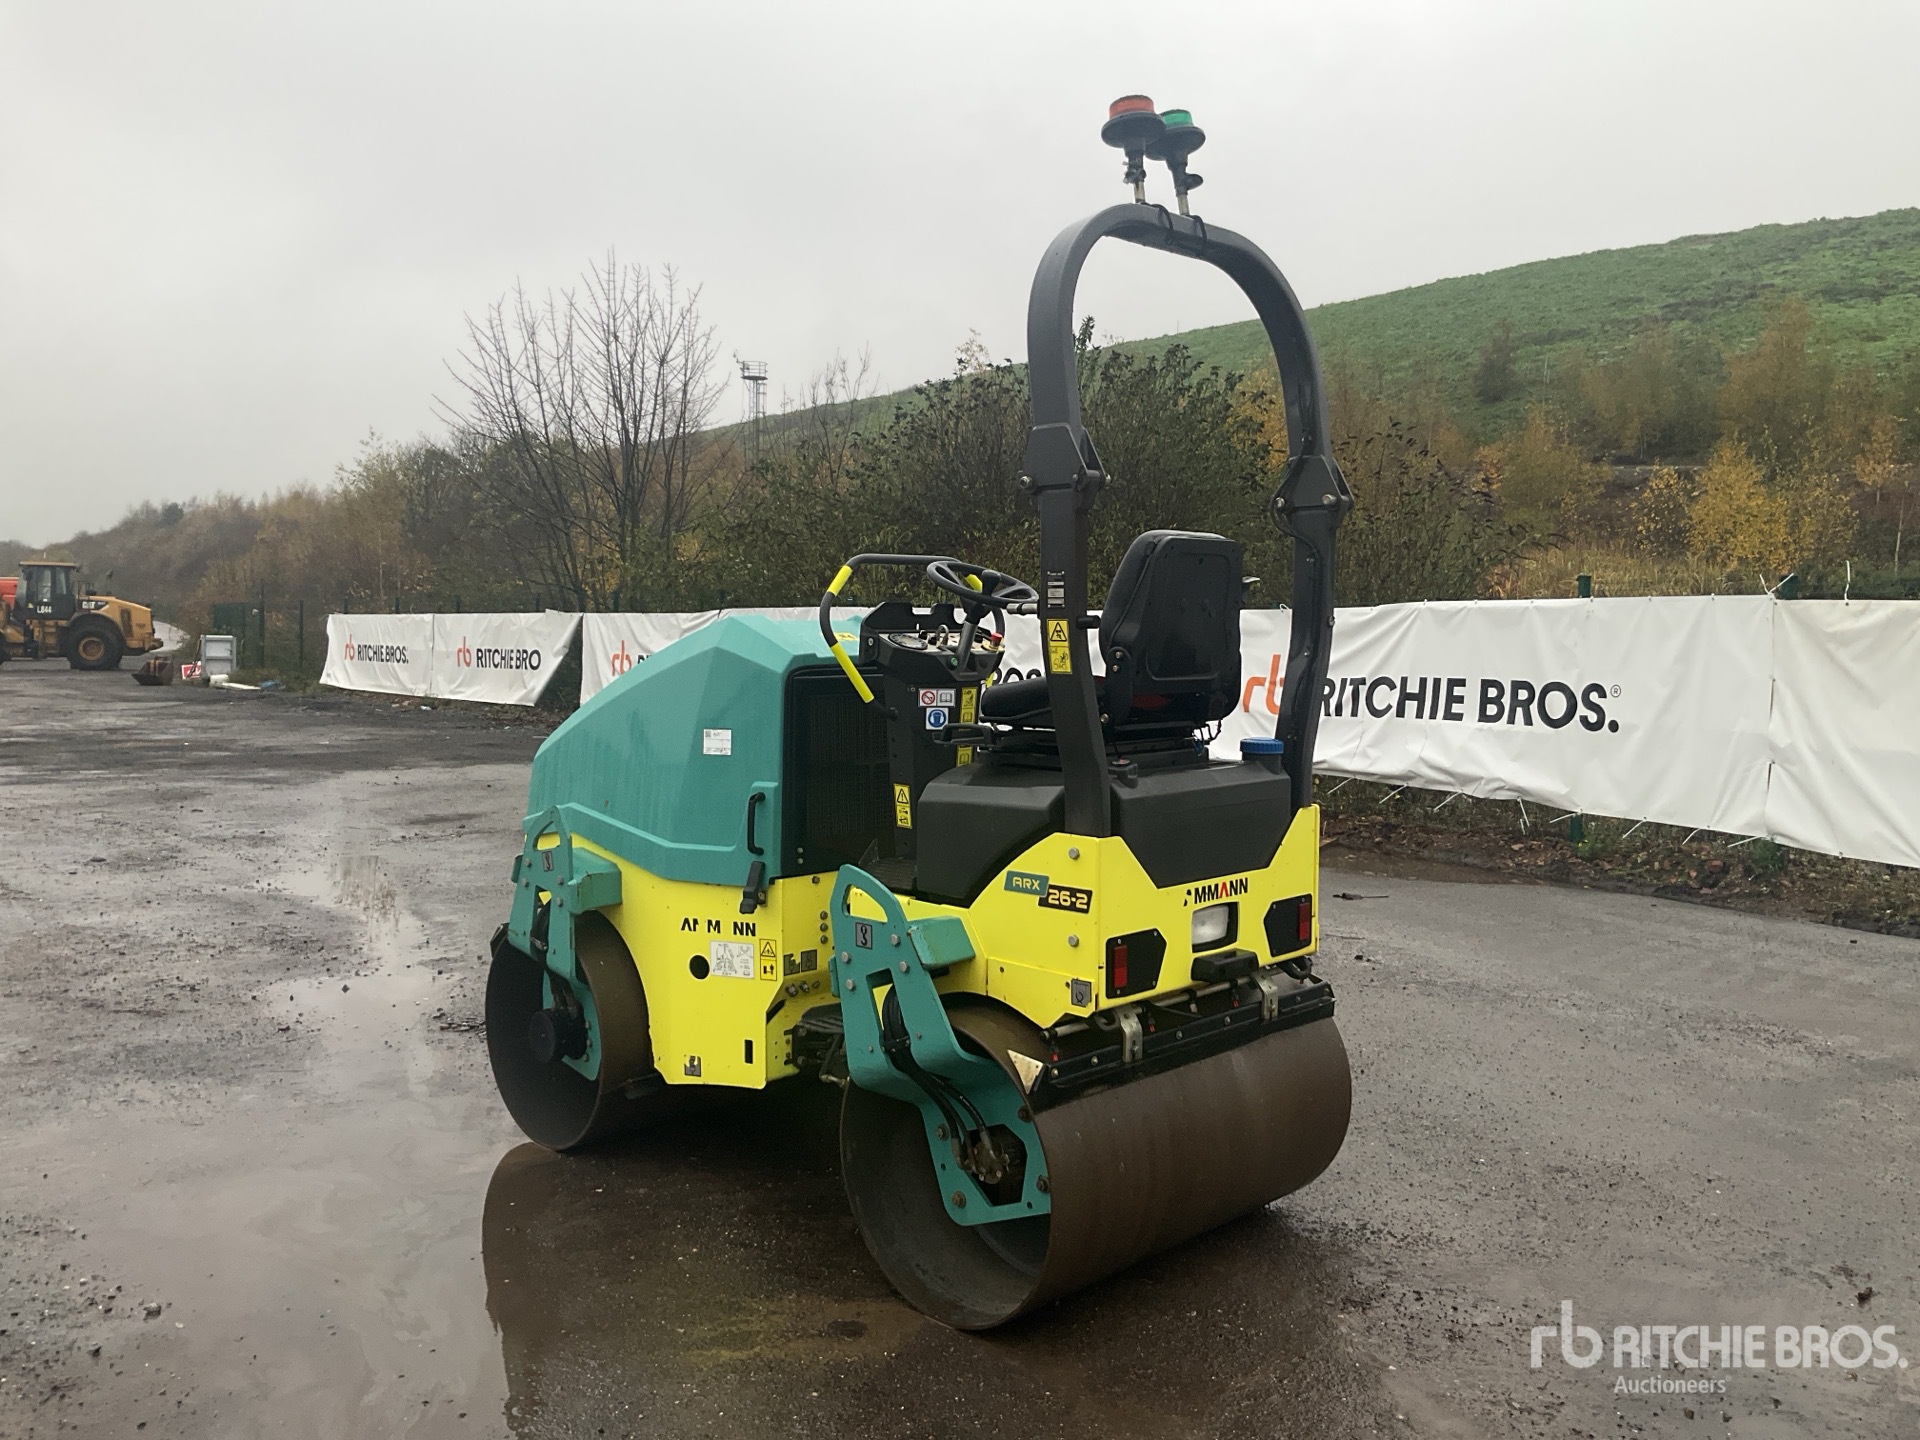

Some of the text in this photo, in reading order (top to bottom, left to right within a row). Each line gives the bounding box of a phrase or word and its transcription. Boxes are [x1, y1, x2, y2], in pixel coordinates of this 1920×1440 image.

[357, 644, 384, 662] RITCHIE
[476, 648, 513, 669] RITCHIE
[515, 649, 541, 670] BRO
[1320, 676, 1466, 721] RITCHIE
[1012, 876, 1088, 909] ARX 26-2
